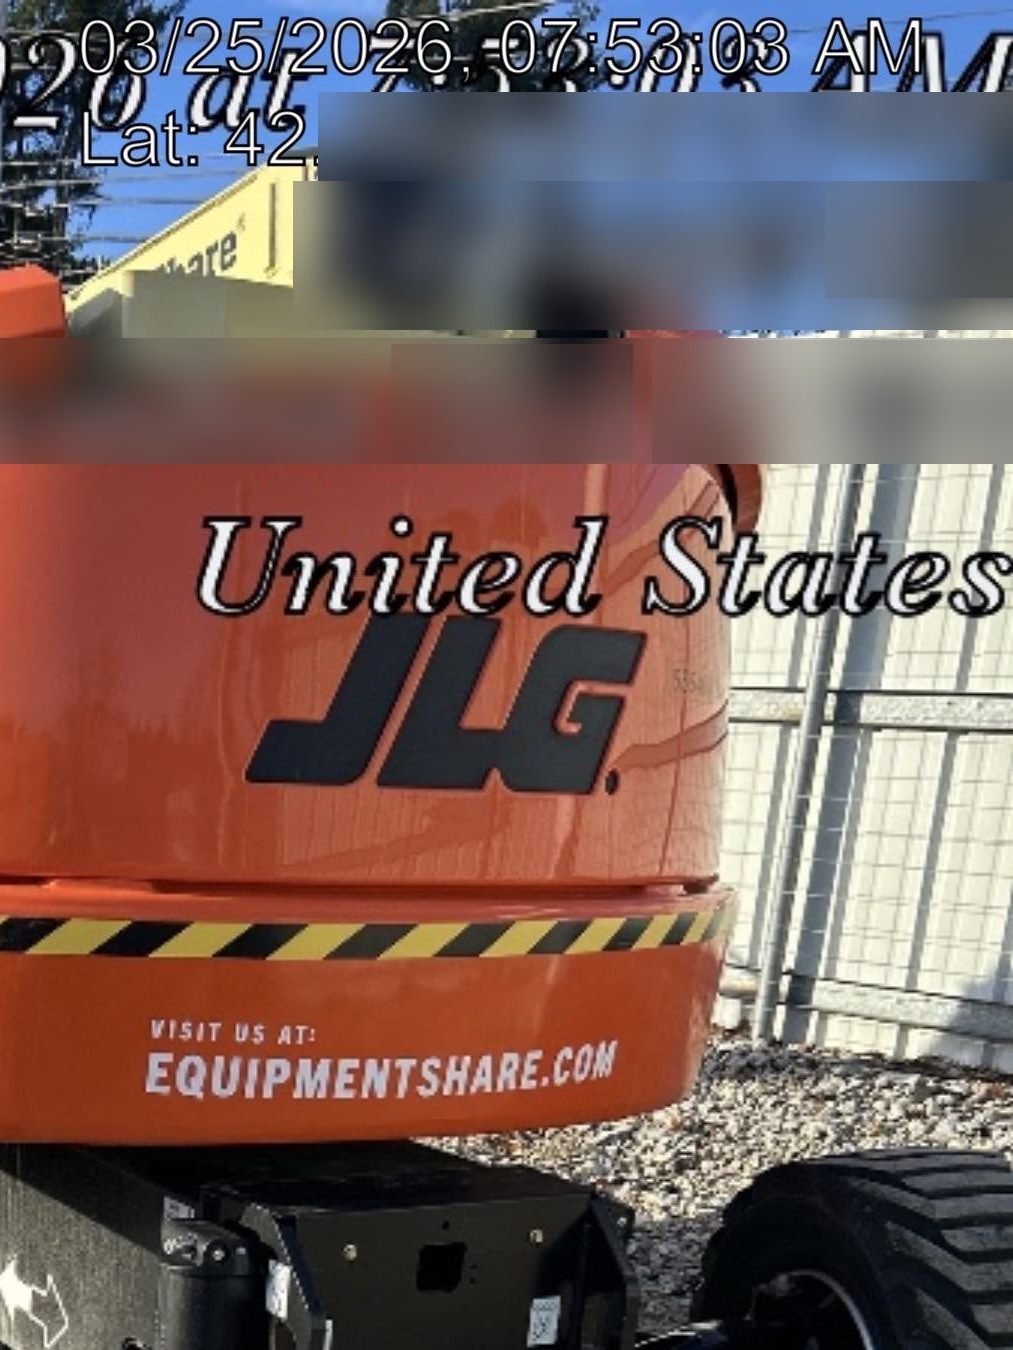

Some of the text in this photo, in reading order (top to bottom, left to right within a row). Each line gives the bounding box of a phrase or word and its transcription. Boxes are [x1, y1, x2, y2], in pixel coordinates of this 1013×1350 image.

[244, 610, 647, 795] JLG
[150, 1018, 316, 1045] VISIT US AT:
[145, 1038, 619, 1100] EQUIPMENTSHARE.COM
